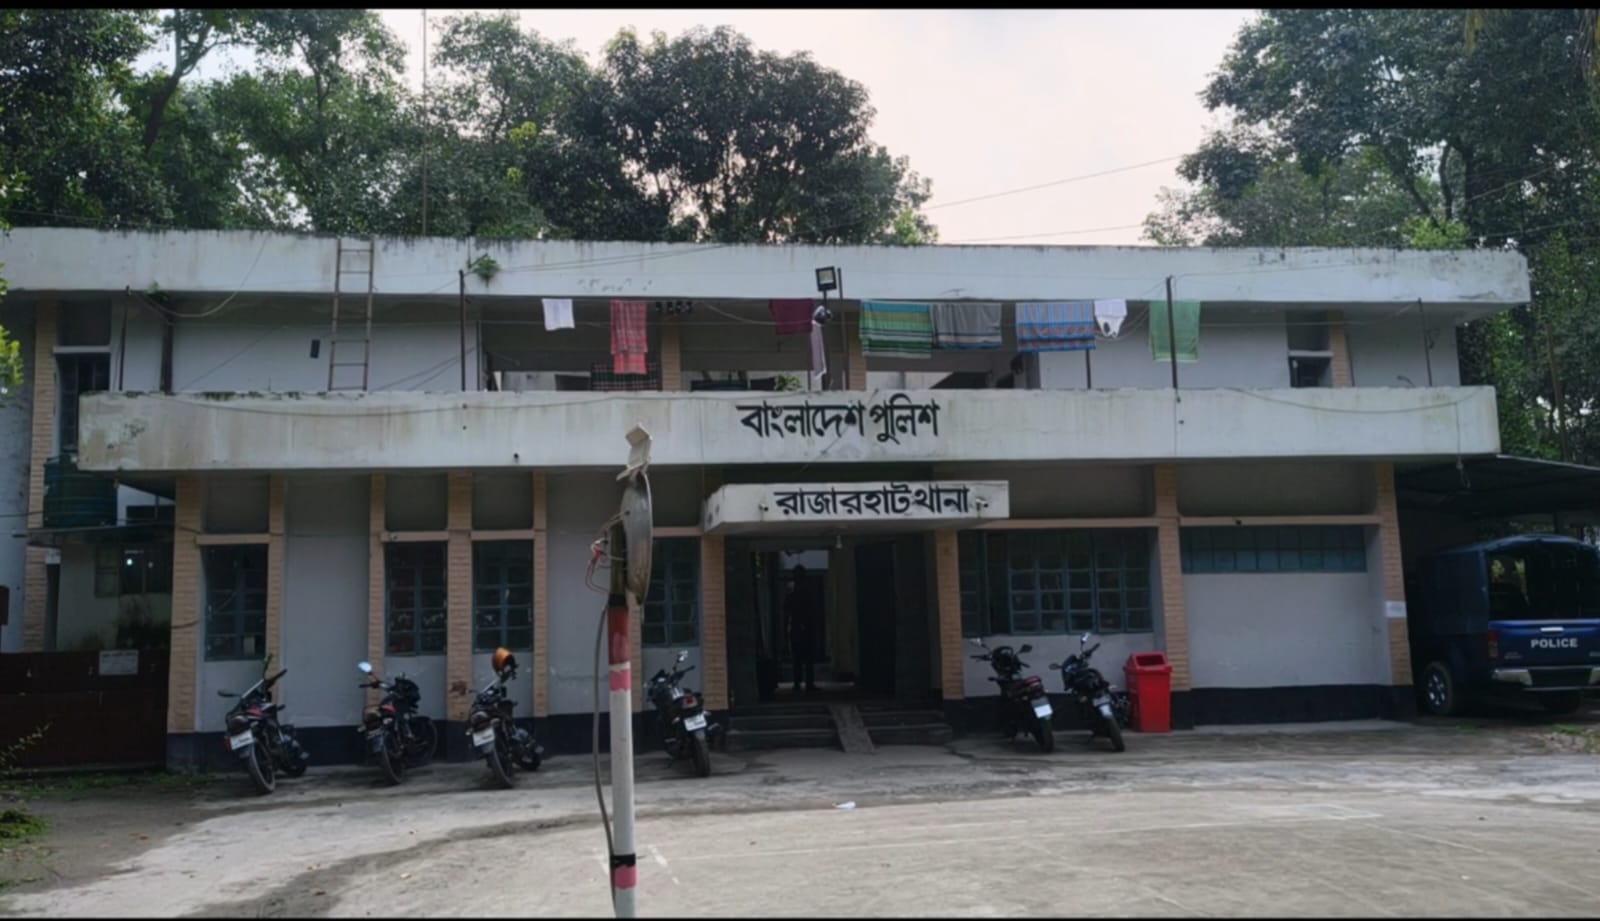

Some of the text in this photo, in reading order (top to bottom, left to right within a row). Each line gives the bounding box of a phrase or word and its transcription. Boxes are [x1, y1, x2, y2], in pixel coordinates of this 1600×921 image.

[736, 393, 940, 445] বাংলাদেশ পুলিশ
[773, 482, 970, 515] রাজারহাট থানা
[1530, 638, 1578, 649] POLICE
